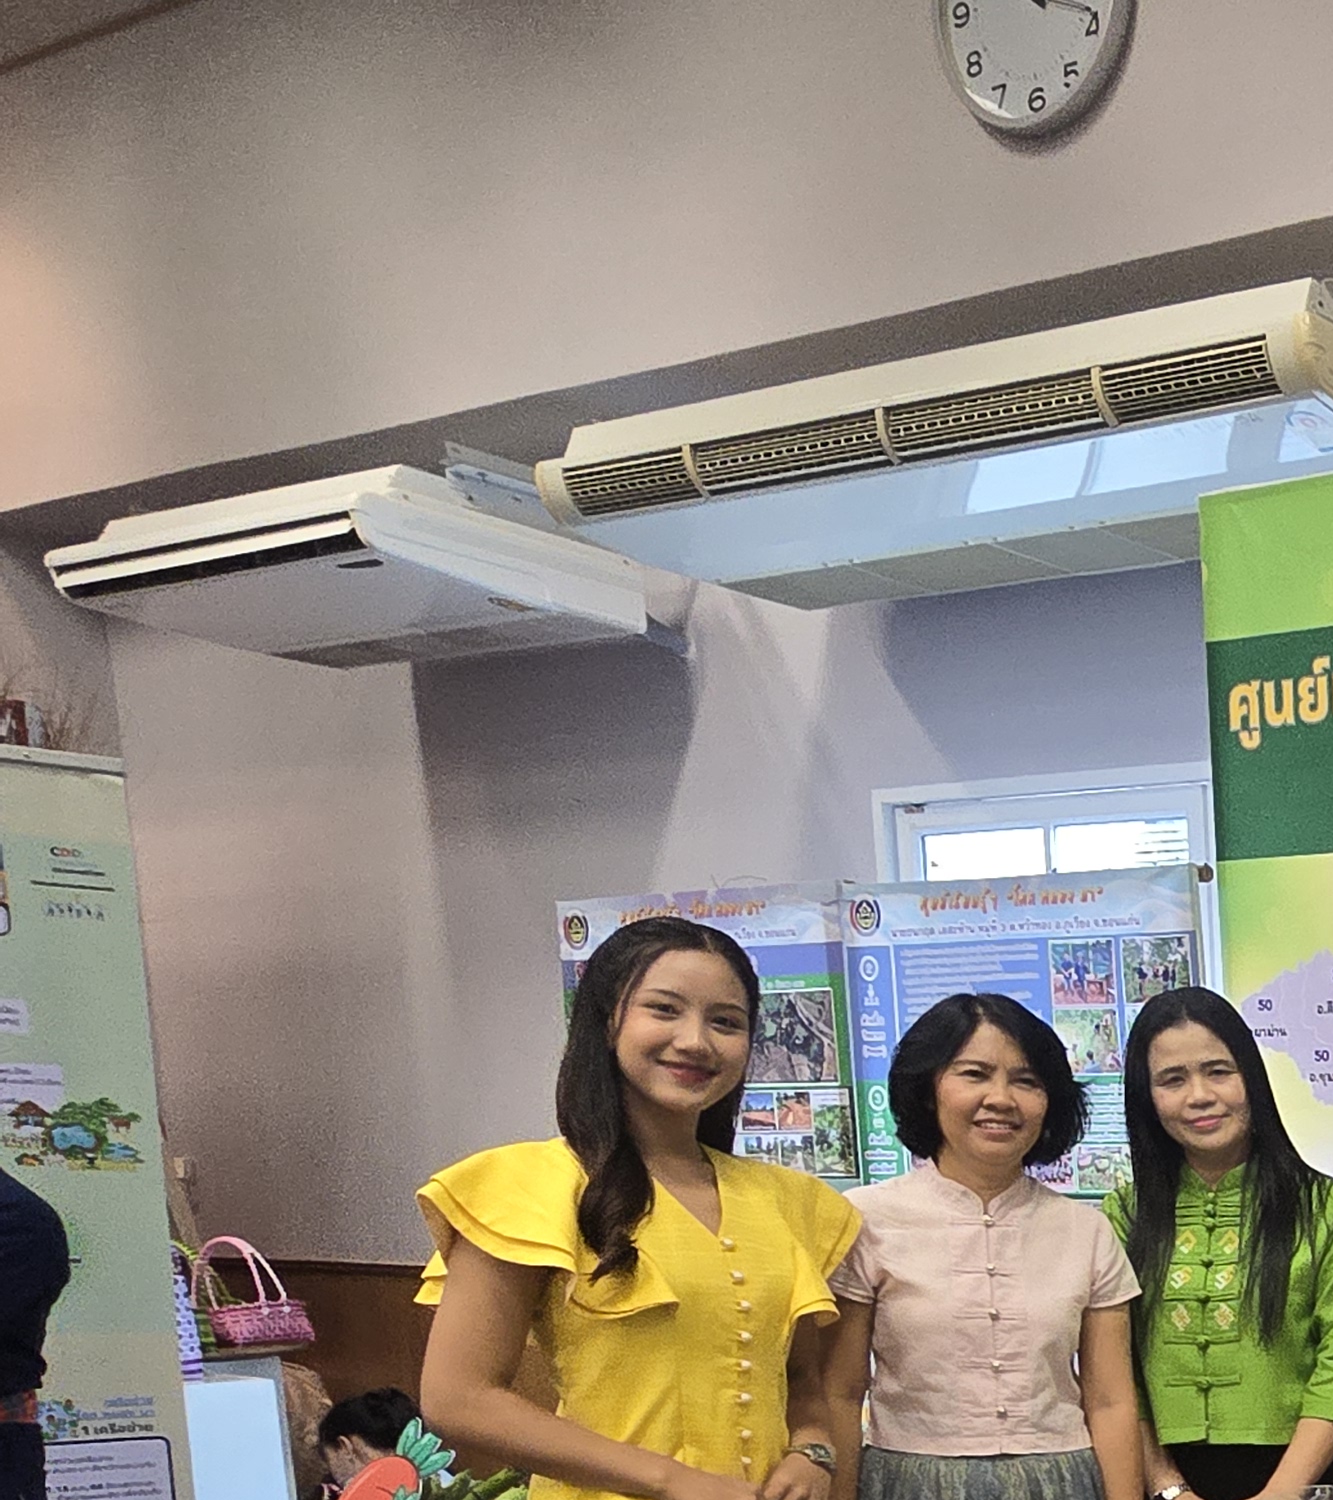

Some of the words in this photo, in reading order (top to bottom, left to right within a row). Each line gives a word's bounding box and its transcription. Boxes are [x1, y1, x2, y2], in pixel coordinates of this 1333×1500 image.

[953, 2, 970, 28] 9
[966, 50, 982, 77] 8
[992, 84, 1007, 109] 7
[1028, 87, 1046, 112] 6
[1258, 1000, 1272, 1011] 50
[1314, 1050, 1330, 1062] 50
